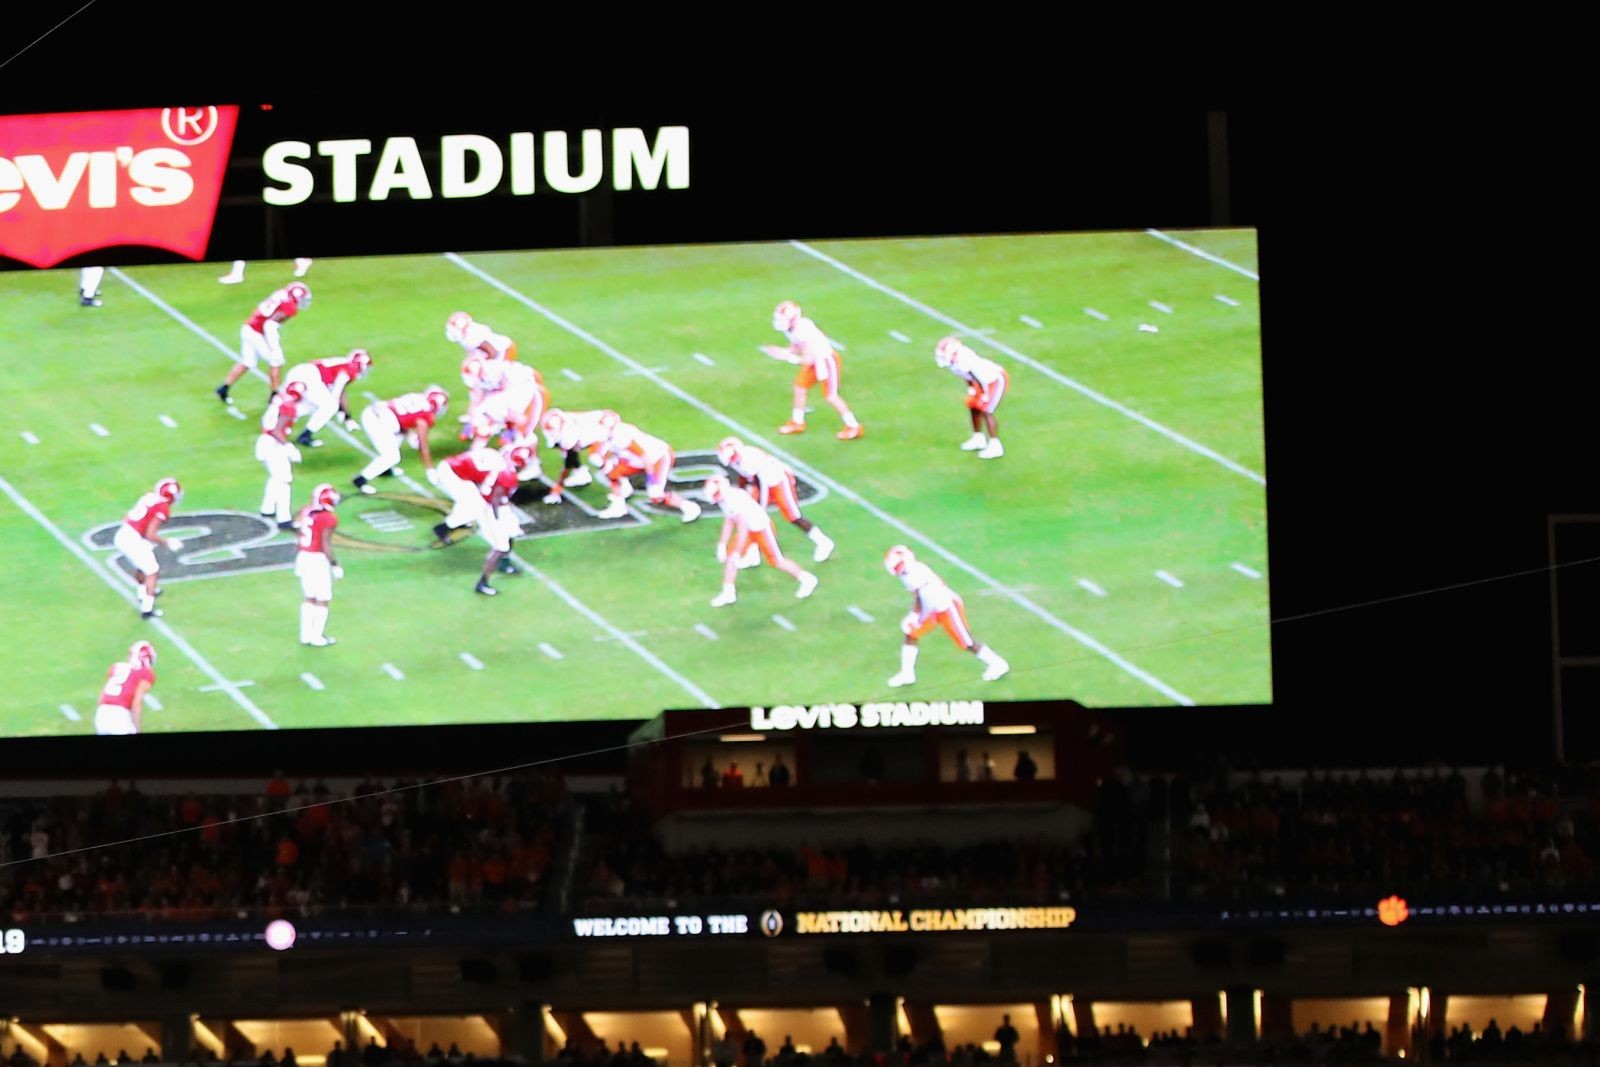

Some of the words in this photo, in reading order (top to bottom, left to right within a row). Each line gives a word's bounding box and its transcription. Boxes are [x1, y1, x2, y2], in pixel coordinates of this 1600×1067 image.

[262, 126, 691, 207] STADIUM
[859, 700, 984, 728] STADIUM
[574, 916, 670, 937] WELCOME
[675, 917, 703, 936] TO
[707, 915, 749, 935] THE
[796, 910, 908, 934] NATIONAL
[910, 907, 1076, 932] CHAMPIONSHIP
